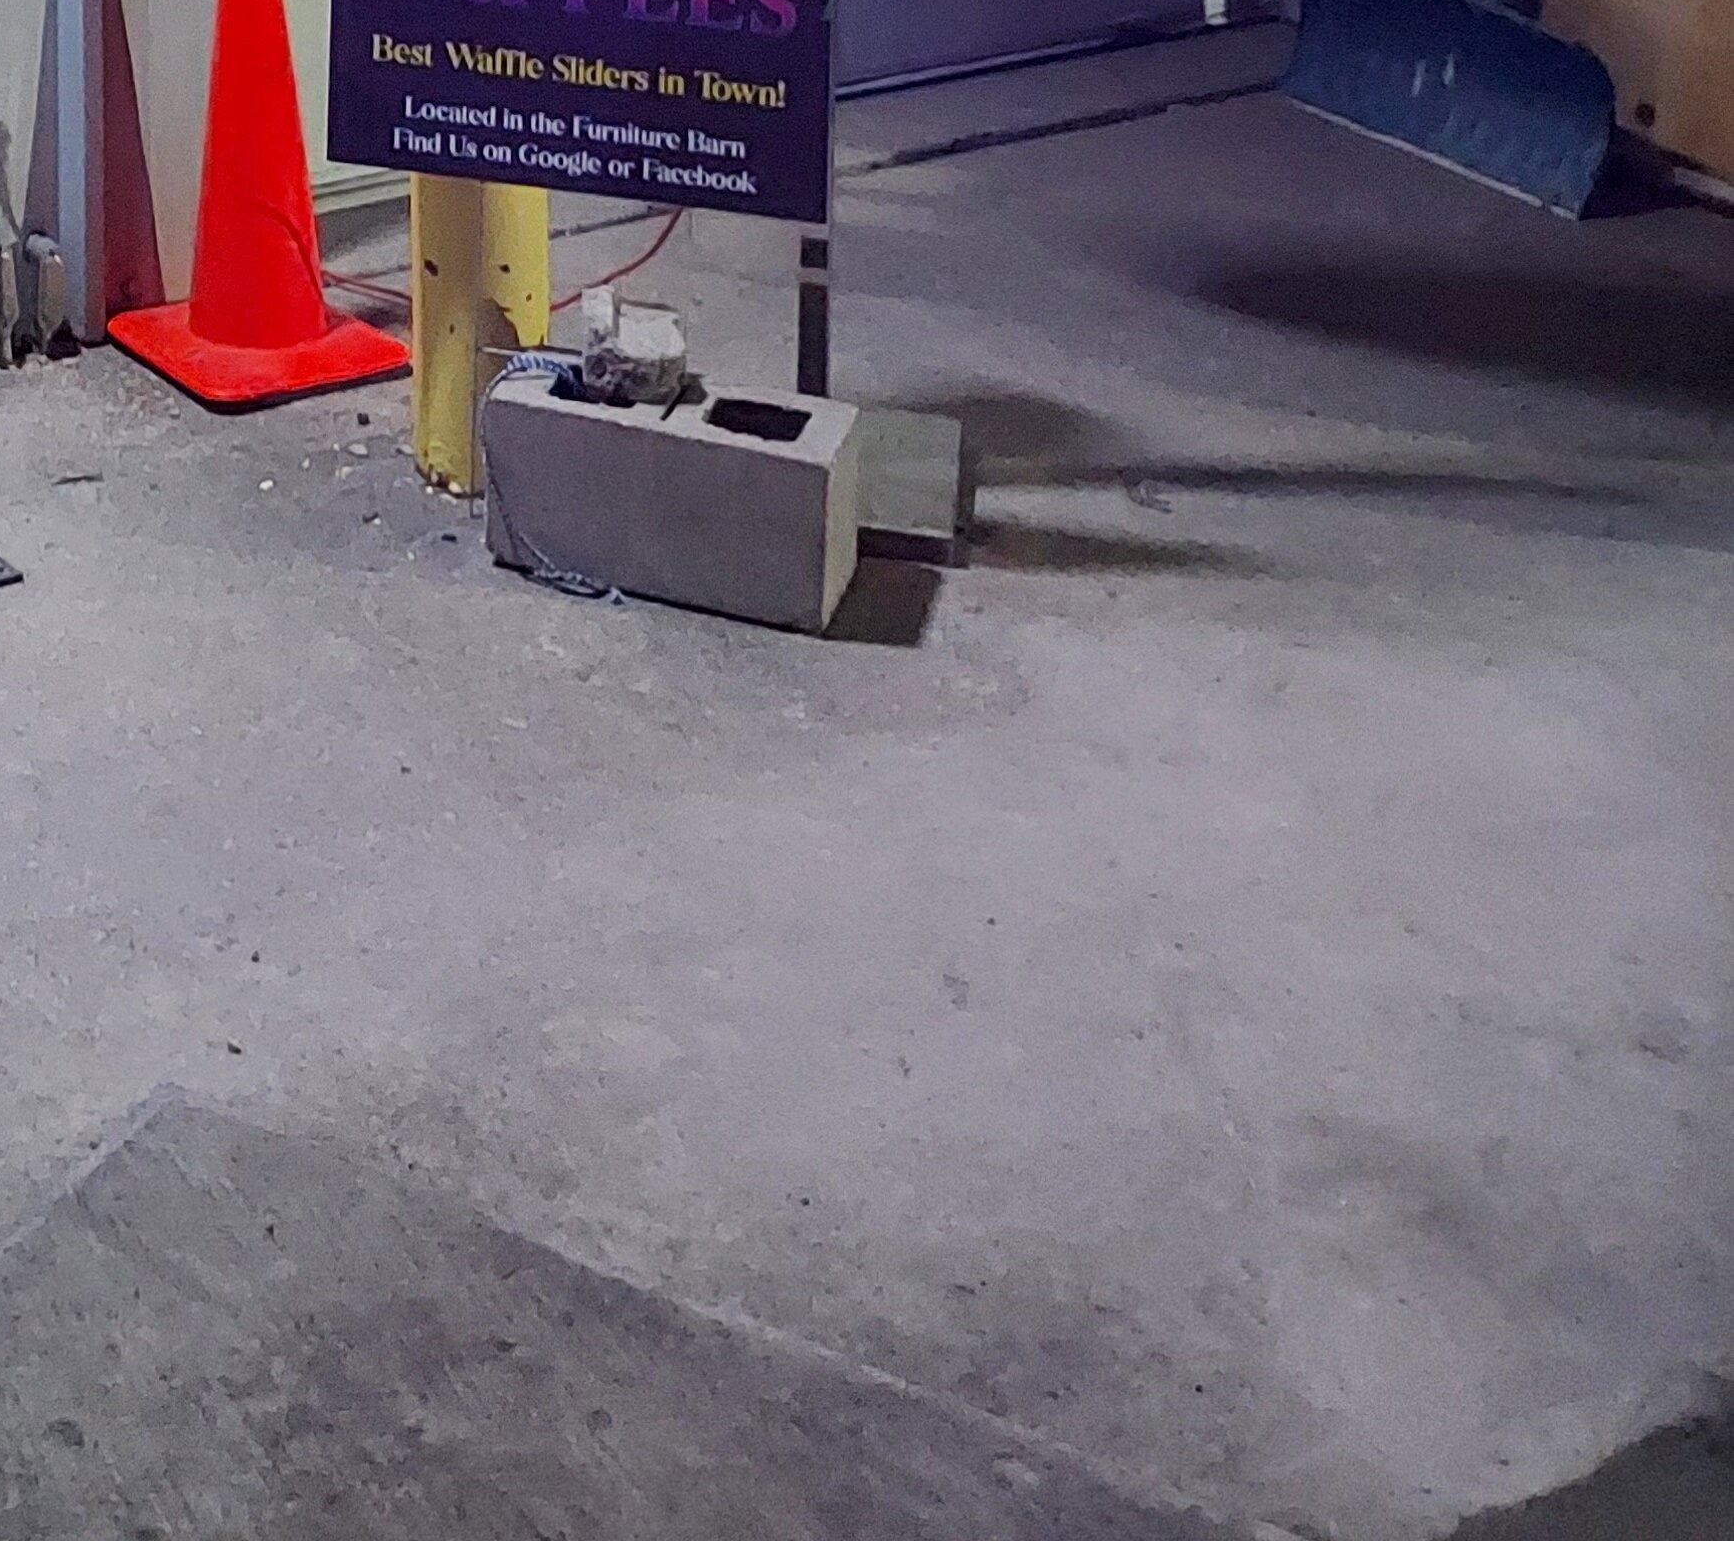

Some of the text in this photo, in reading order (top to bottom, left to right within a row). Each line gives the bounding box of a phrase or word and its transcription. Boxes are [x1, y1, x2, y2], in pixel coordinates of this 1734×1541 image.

[372, 33, 786, 108] Best Waffle Sliders in Town!
[393, 126, 758, 194] Find Us on Google or Facebook
[405, 95, 746, 159] Located in the Furniture Barn
